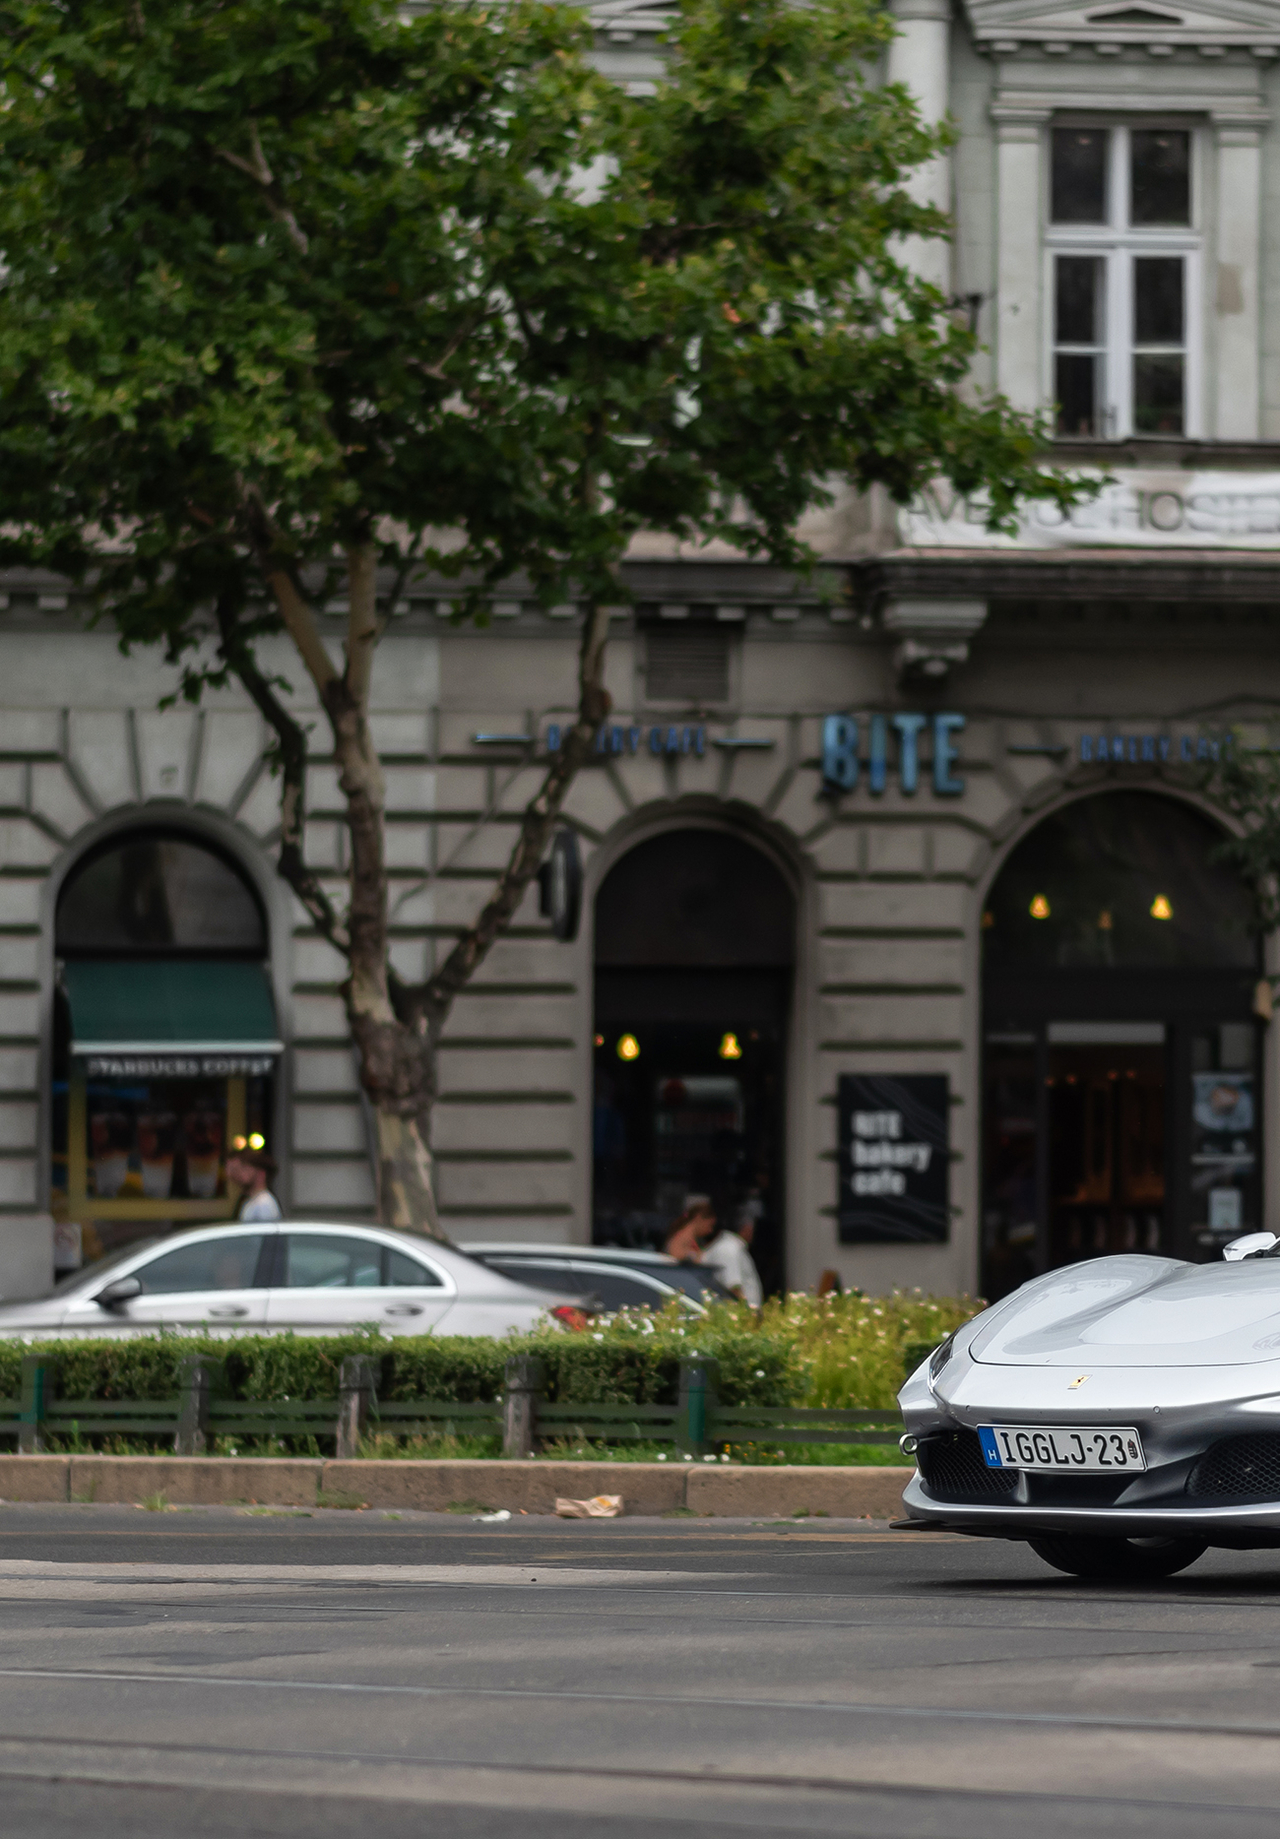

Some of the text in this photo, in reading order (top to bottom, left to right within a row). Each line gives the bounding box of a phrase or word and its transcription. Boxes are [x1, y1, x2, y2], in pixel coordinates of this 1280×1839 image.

[821, 712, 967, 799] BITE
[1080, 734, 1171, 763] BAKERY
[988, 1450, 998, 1460] H
[1000, 1432, 1128, 1466] IGGLJ-23
